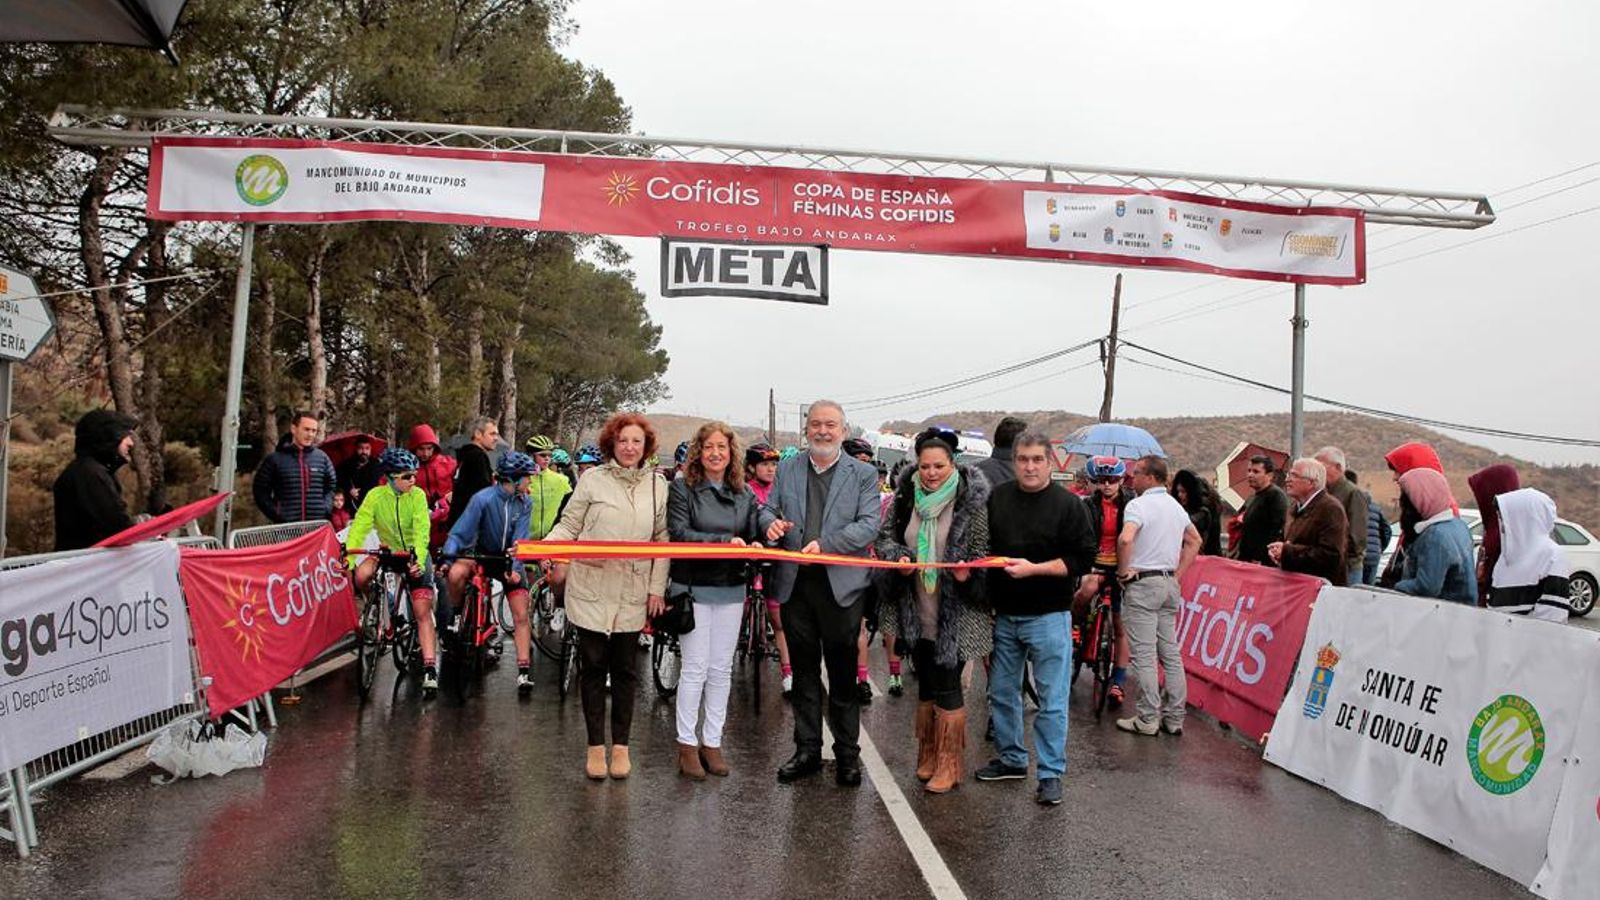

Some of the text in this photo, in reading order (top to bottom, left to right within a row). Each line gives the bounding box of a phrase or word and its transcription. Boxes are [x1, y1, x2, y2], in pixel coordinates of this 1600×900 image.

[306, 166, 467, 188] MANCOMUNIDAD DE MUNICIPIOS
[335, 181, 433, 195] DEL BAJO ANDARAX
[646, 176, 760, 206] Cofidis
[793, 183, 953, 206] COPA DE ESPAÑA
[793, 197, 955, 223] FÉMINAS COFIDIS
[676, 220, 897, 243] TROFEO BAJO ANDARAX
[674, 246, 817, 292] META
[12, 680, 65, 712] Deporte
[68, 663, 111, 695] Español
[1361, 668, 1442, 714] SANTA FE
[1335, 703, 1357, 730] DE
